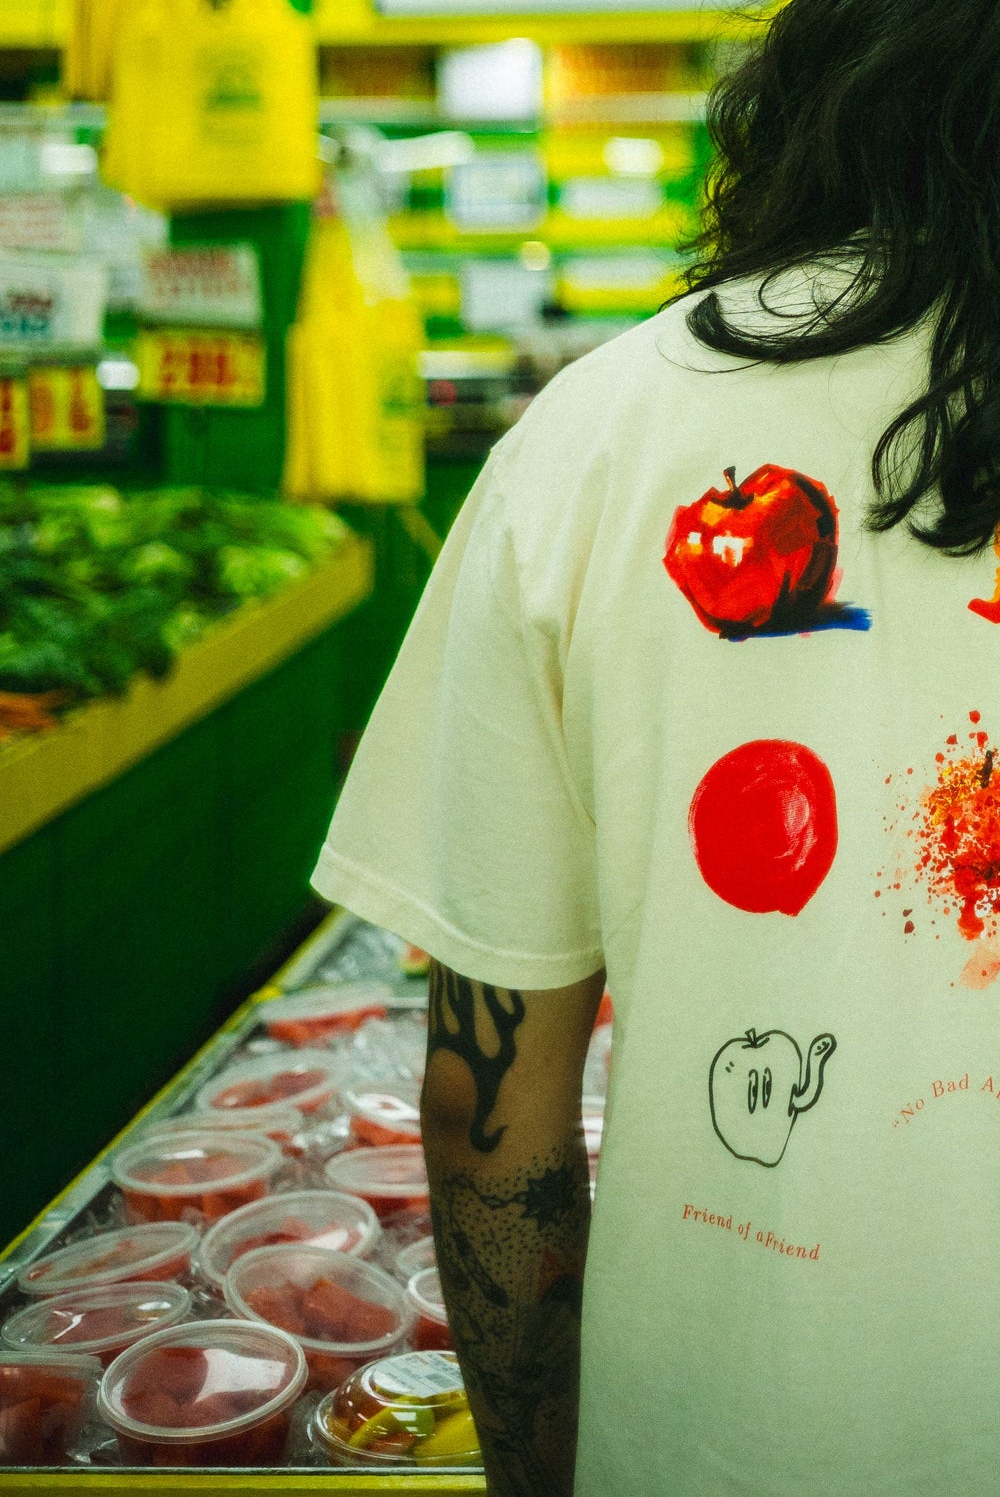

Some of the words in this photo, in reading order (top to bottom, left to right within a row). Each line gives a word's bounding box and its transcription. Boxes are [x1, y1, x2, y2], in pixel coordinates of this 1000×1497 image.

[931, 1072, 971, 1099] Bad
[682, 1204, 734, 1231] Friend
[738, 1221, 752, 1241] of
